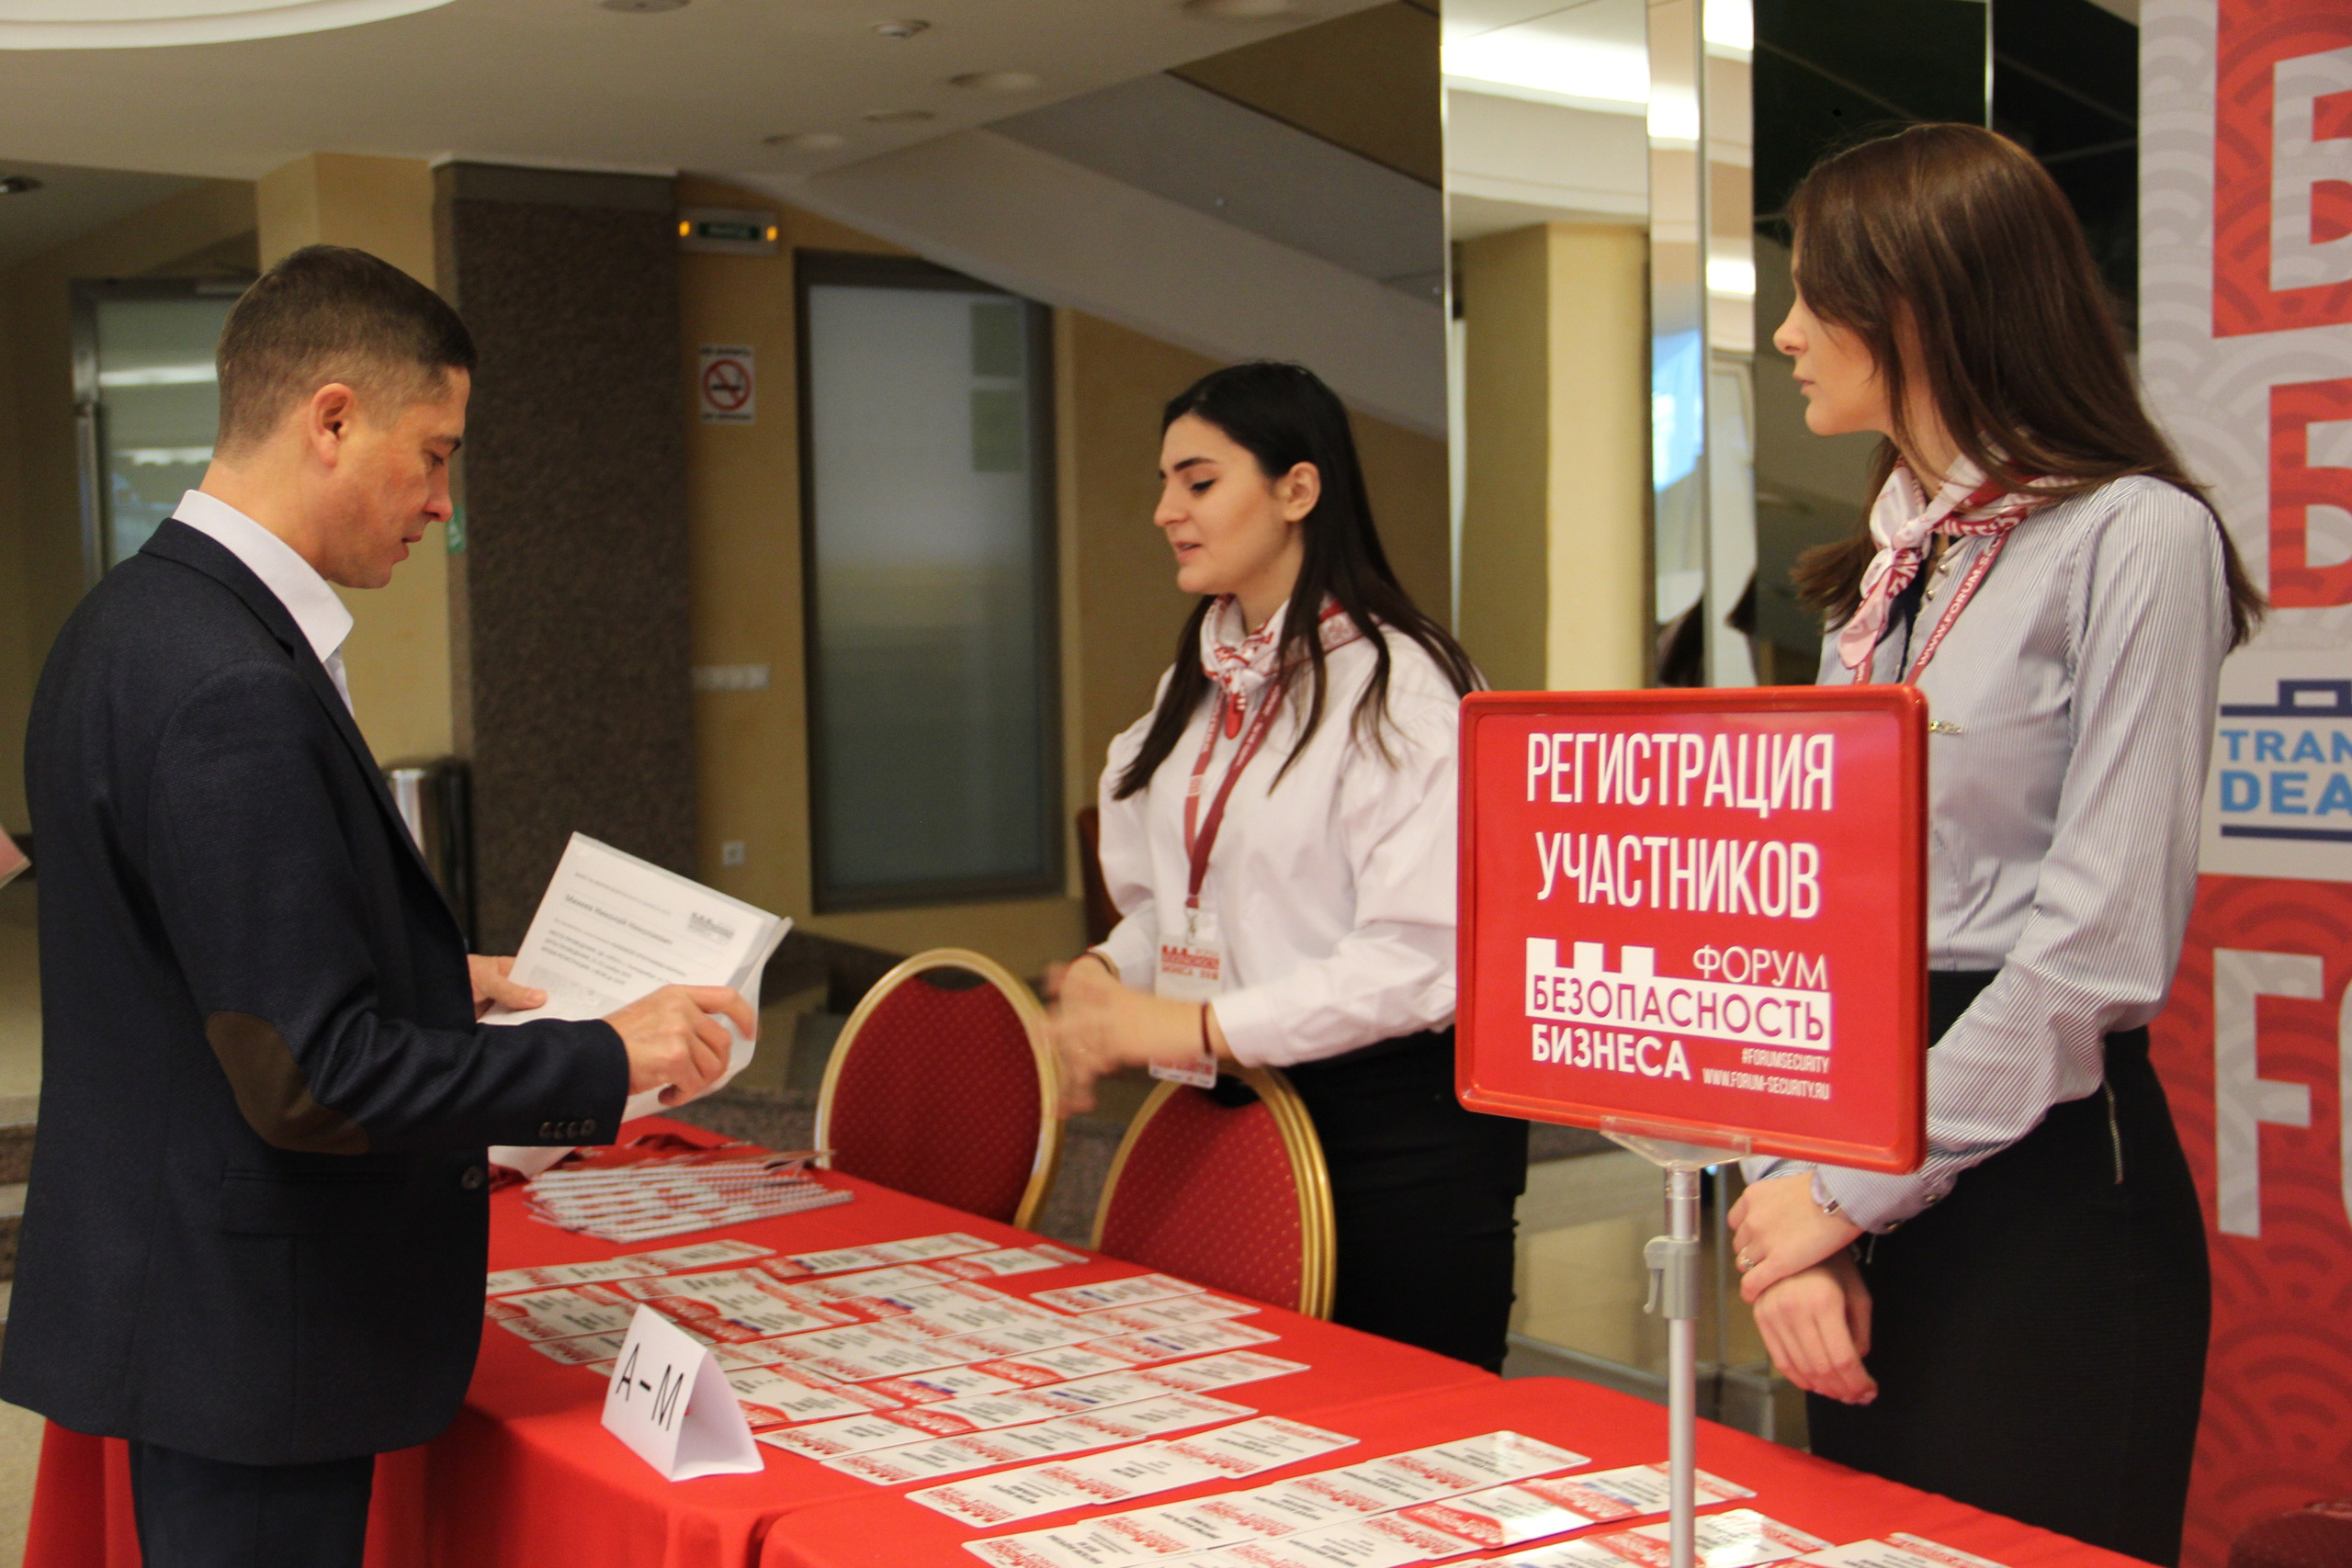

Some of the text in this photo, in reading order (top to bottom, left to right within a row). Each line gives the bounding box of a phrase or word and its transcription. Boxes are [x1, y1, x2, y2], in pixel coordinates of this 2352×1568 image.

[2220, 729, 2352, 763] TRAN
[1527, 732, 1834, 818] РЕГИСТРАЦИЯ
[2221, 770, 2352, 816] DEA
[1534, 831, 1820, 919] УЧАСТНИКОВ
[1692, 944, 1827, 990] ФОРУМ
[1533, 975, 1824, 1041] БЕЗОПАСНОСТЬ
[1532, 1023, 1690, 1081] БИЗНЕСА
[1741, 1047, 1830, 1074] #FORUMSECURITY
[1702, 1067, 1830, 1100] WWW.FORUM-SECURITY.RU
[2214, 947, 2352, 1238] F
